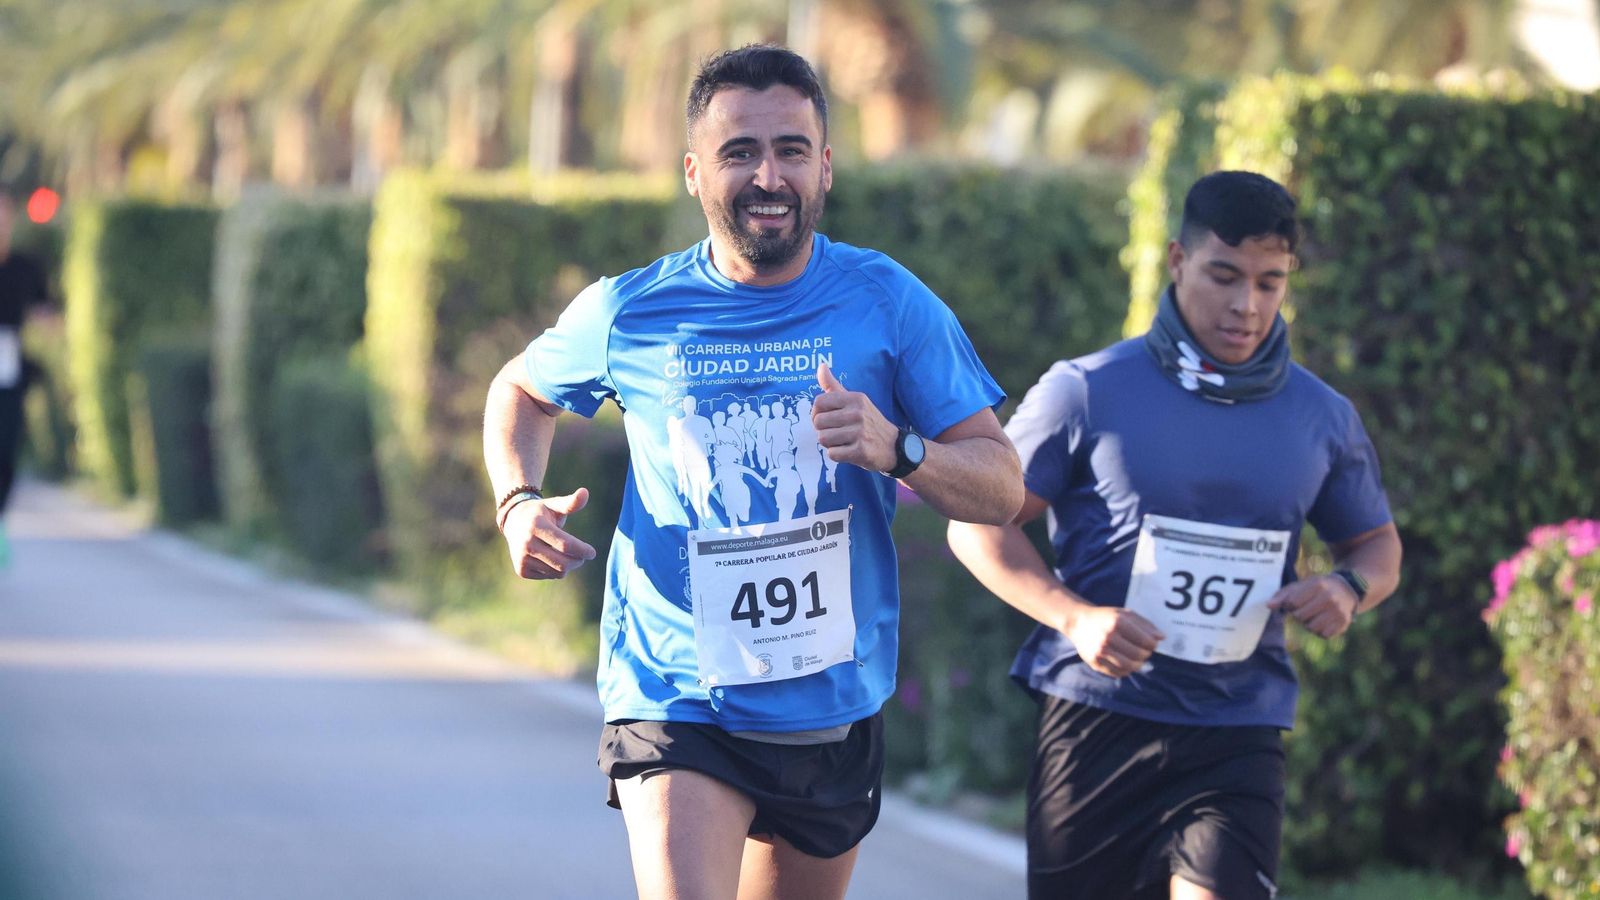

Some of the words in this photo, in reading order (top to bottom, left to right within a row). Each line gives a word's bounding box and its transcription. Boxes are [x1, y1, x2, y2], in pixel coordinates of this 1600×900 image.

[665, 344, 682, 356] VII
[685, 343, 752, 355] CARRERA
[754, 339, 811, 352] URBANA
[814, 336, 832, 348] DE
[664, 359, 749, 378] CIUDAD
[753, 348, 832, 373] JARDÍN
[701, 377, 740, 386] Fundación
[741, 375, 767, 384] Unicaja
[767, 374, 798, 383] Sagrada
[799, 373, 818, 381] Fami
[711, 535, 789, 550] www.deporte.malaga.eu
[723, 558, 755, 567] CARRERA
[756, 552, 787, 564] POPULAR
[797, 546, 819, 557] CIUDAD
[819, 540, 838, 552] JARDÍN
[731, 571, 827, 629] 491
[1165, 570, 1256, 618] 367
[753, 636, 781, 645] ANTONIO
[791, 631, 805, 639] PINO
[805, 628, 817, 636] RUIZ
